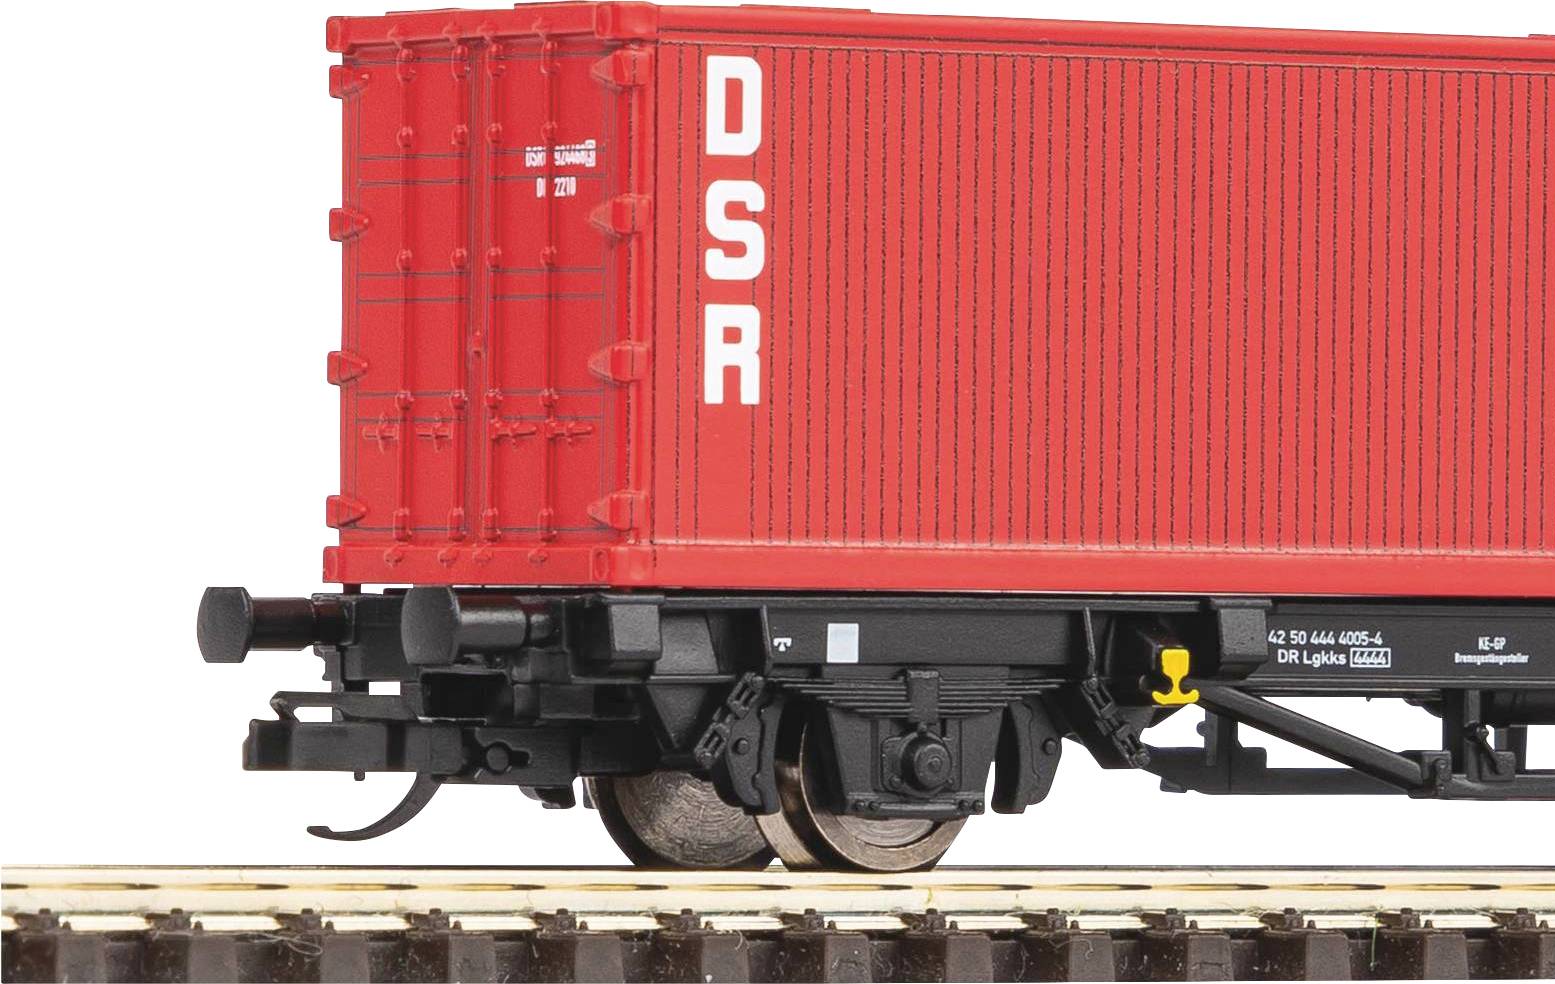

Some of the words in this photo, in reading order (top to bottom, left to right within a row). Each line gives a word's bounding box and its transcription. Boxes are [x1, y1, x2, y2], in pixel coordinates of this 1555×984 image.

[554, 177, 576, 196] 2210
[1268, 630, 1286, 644] 42
[1290, 630, 1307, 645] 50
[1310, 631, 1336, 645] 444
[1338, 631, 1383, 646] 4005-4
[1278, 649, 1299, 664] DR
[1303, 650, 1347, 668] Lgkks
[1354, 651, 1387, 665] 4444
